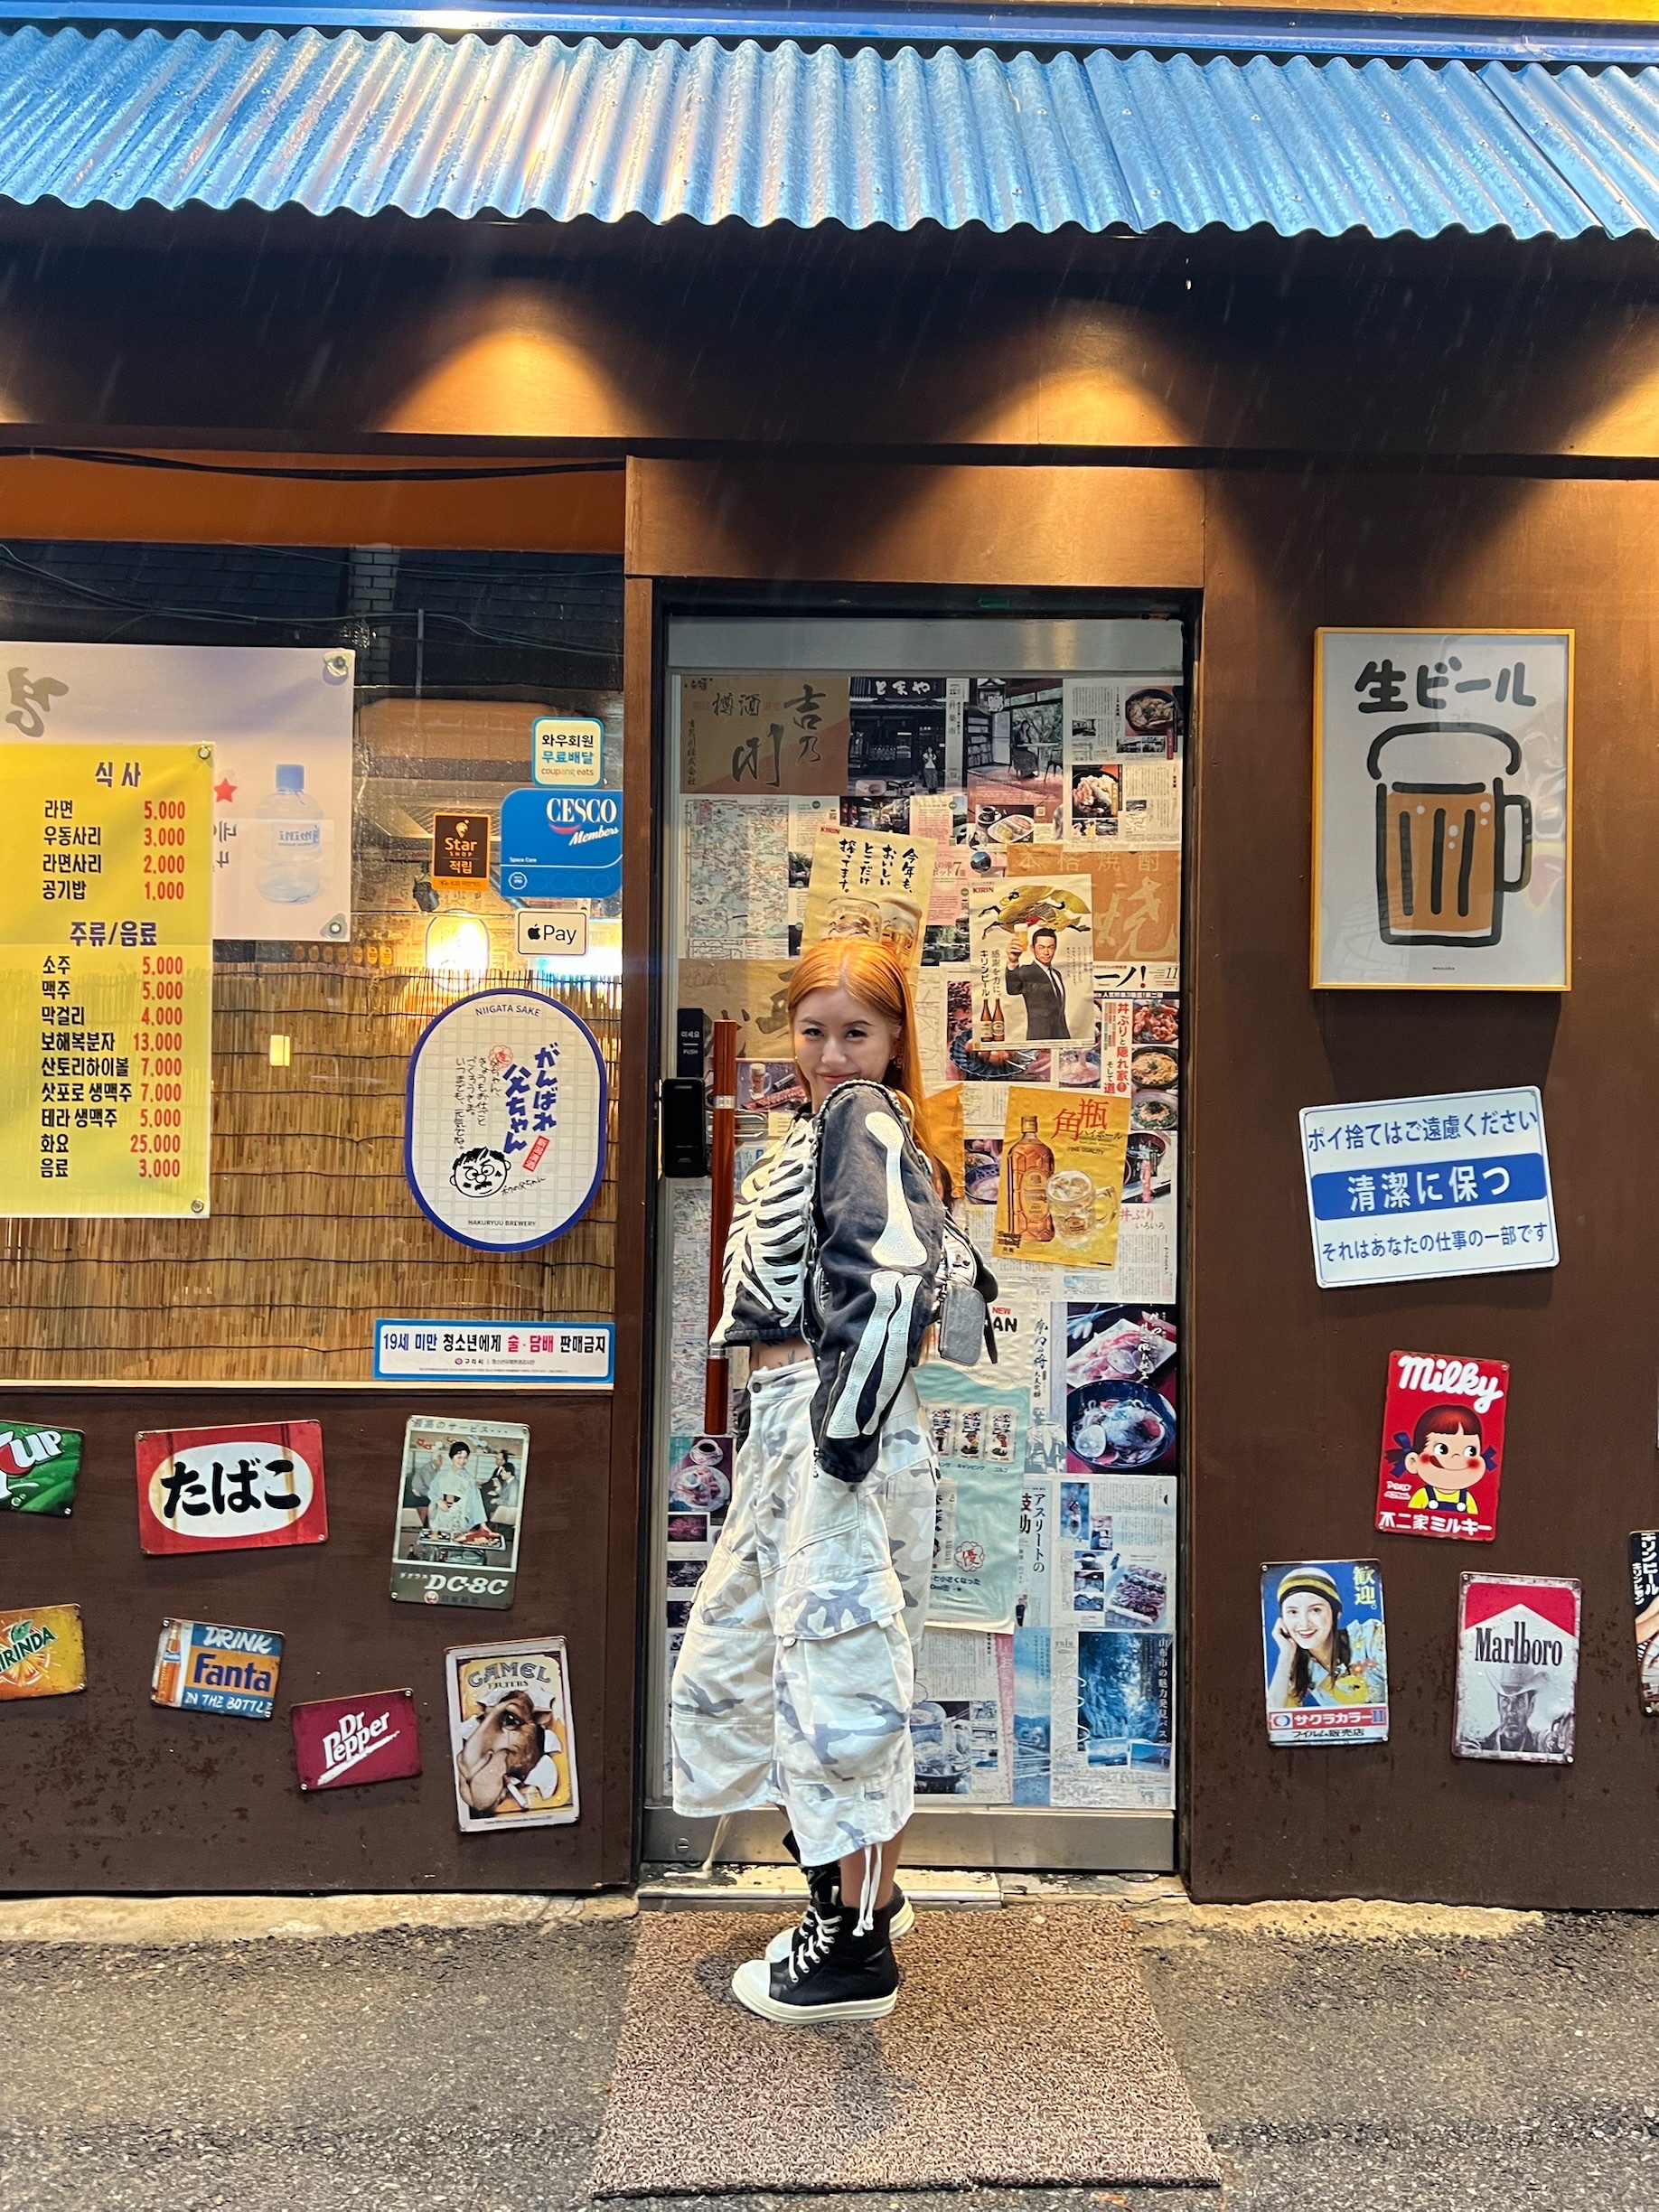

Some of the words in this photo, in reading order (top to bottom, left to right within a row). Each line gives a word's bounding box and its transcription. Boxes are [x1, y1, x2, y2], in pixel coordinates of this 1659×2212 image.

[1354, 656, 1537, 713] 生ビール
[541, 734, 594, 748] 와우회원
[541, 751, 594, 765] 무료배달
[541, 767, 576, 777] coupang
[44, 800, 73, 820] 라면
[546, 797, 617, 823] CESCO
[43, 826, 101, 847] 우동사리
[444, 837, 478, 853] Star
[568, 826, 619, 846] Members
[42, 853, 102, 875] 라면사리
[449, 859, 473, 874] 적립
[859, 842, 873, 885] とこだけ
[879, 844, 897, 886] おいしい
[42, 879, 87, 901] 공기밥
[70, 921, 157, 946] 주류/음료
[543, 924, 576, 945] Pay
[42, 955, 70, 975] 소주
[979, 950, 990, 997] キリンビール
[42, 981, 70, 1000] 맥주
[42, 1007, 85, 1026] 막걸리
[475, 1004, 513, 1017] NIIGATA
[515, 1004, 541, 1017] SAKE
[41, 1032, 115, 1052] 보해복분자
[41, 1057, 129, 1077] 산토리하이볼
[42, 1083, 85, 1102] 삿포로
[89, 1083, 132, 1102] 생맥주
[531, 1041, 561, 1132] がんばれ
[41, 1109, 70, 1128] 테라
[74, 1109, 118, 1128] 생맥주
[502, 1064, 532, 1155] 父ちゃん
[1050, 1097, 1110, 1141] 角瓶
[1308, 1109, 1538, 1152] ポイ捨てはご遠慮ください
[40, 1134, 70, 1154] 화요
[40, 1158, 69, 1178] 음료
[1347, 1166, 1511, 1213] 清潔に保つ
[1322, 1223, 1548, 1262] それはあなたの仕事の一部です
[992, 1307, 1012, 1315] NEW
[992, 1317, 1017, 1333] AN
[383, 1332, 409, 1352] 19세
[414, 1333, 438, 1352] 미만
[443, 1333, 501, 1353] 청소년에게
[560, 1335, 605, 1354] 판매금지
[161, 1457, 301, 1519] たばこ
[1032, 1494, 1046, 1573] アスリートの
[1380, 1511, 1492, 1535] 不二家ミルキー
[424, 1573, 510, 1595] DC-8C
[202, 1626, 273, 1654] DRINK
[1475, 1621, 1563, 1666] Marlboro
[192, 1653, 271, 1692] Fanta
[467, 1662, 551, 1691] CAMEL
[488, 1680, 530, 1690] FILTERS
[185, 1692, 198, 1704] IN
[202, 1693, 223, 1709] THE
[226, 1695, 274, 1713] BOTTLE
[338, 1711, 365, 1739] Dr
[1293, 1711, 1373, 1727] サクラカラー
[322, 1712, 390, 1769] Pepper
